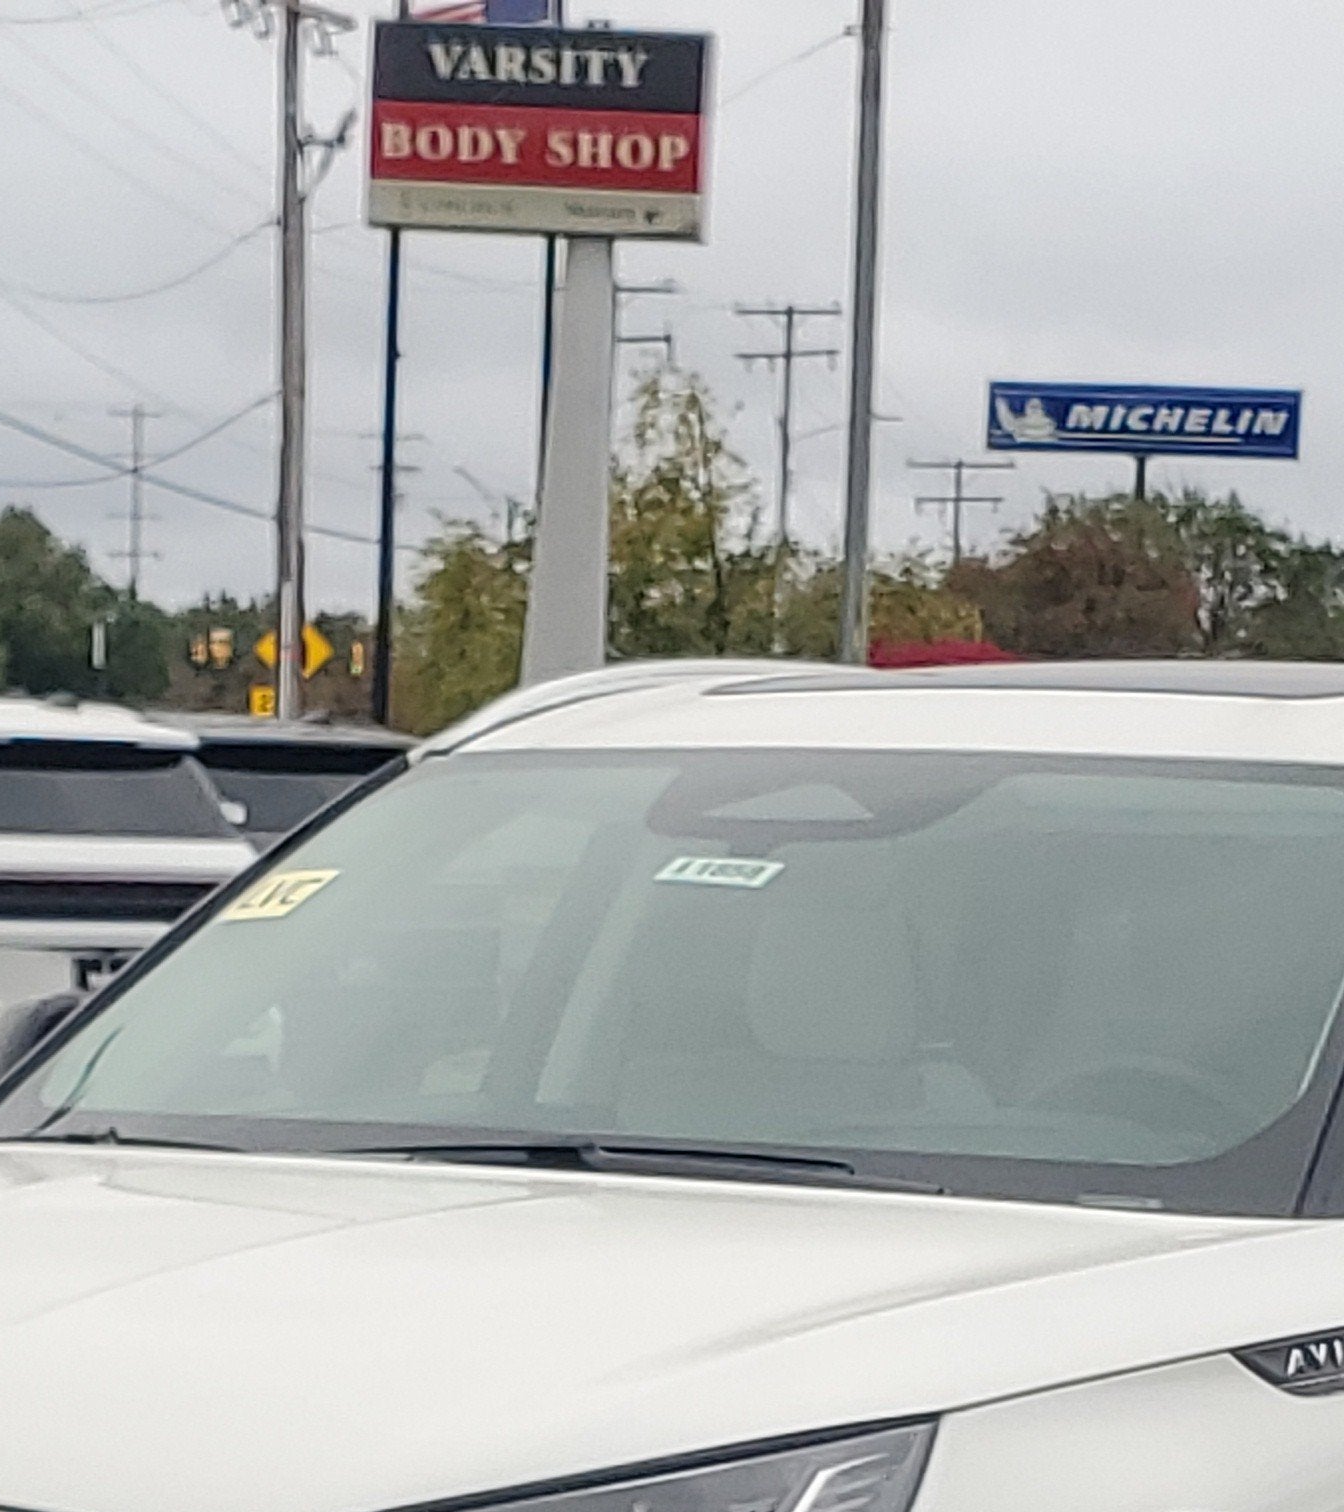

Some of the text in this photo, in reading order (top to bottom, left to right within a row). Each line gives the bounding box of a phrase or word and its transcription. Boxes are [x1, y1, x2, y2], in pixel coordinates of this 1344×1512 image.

[428, 42, 648, 88] VARSITY
[380, 121, 691, 173] BODY SHOP
[1066, 404, 1289, 435] MICHELIN
